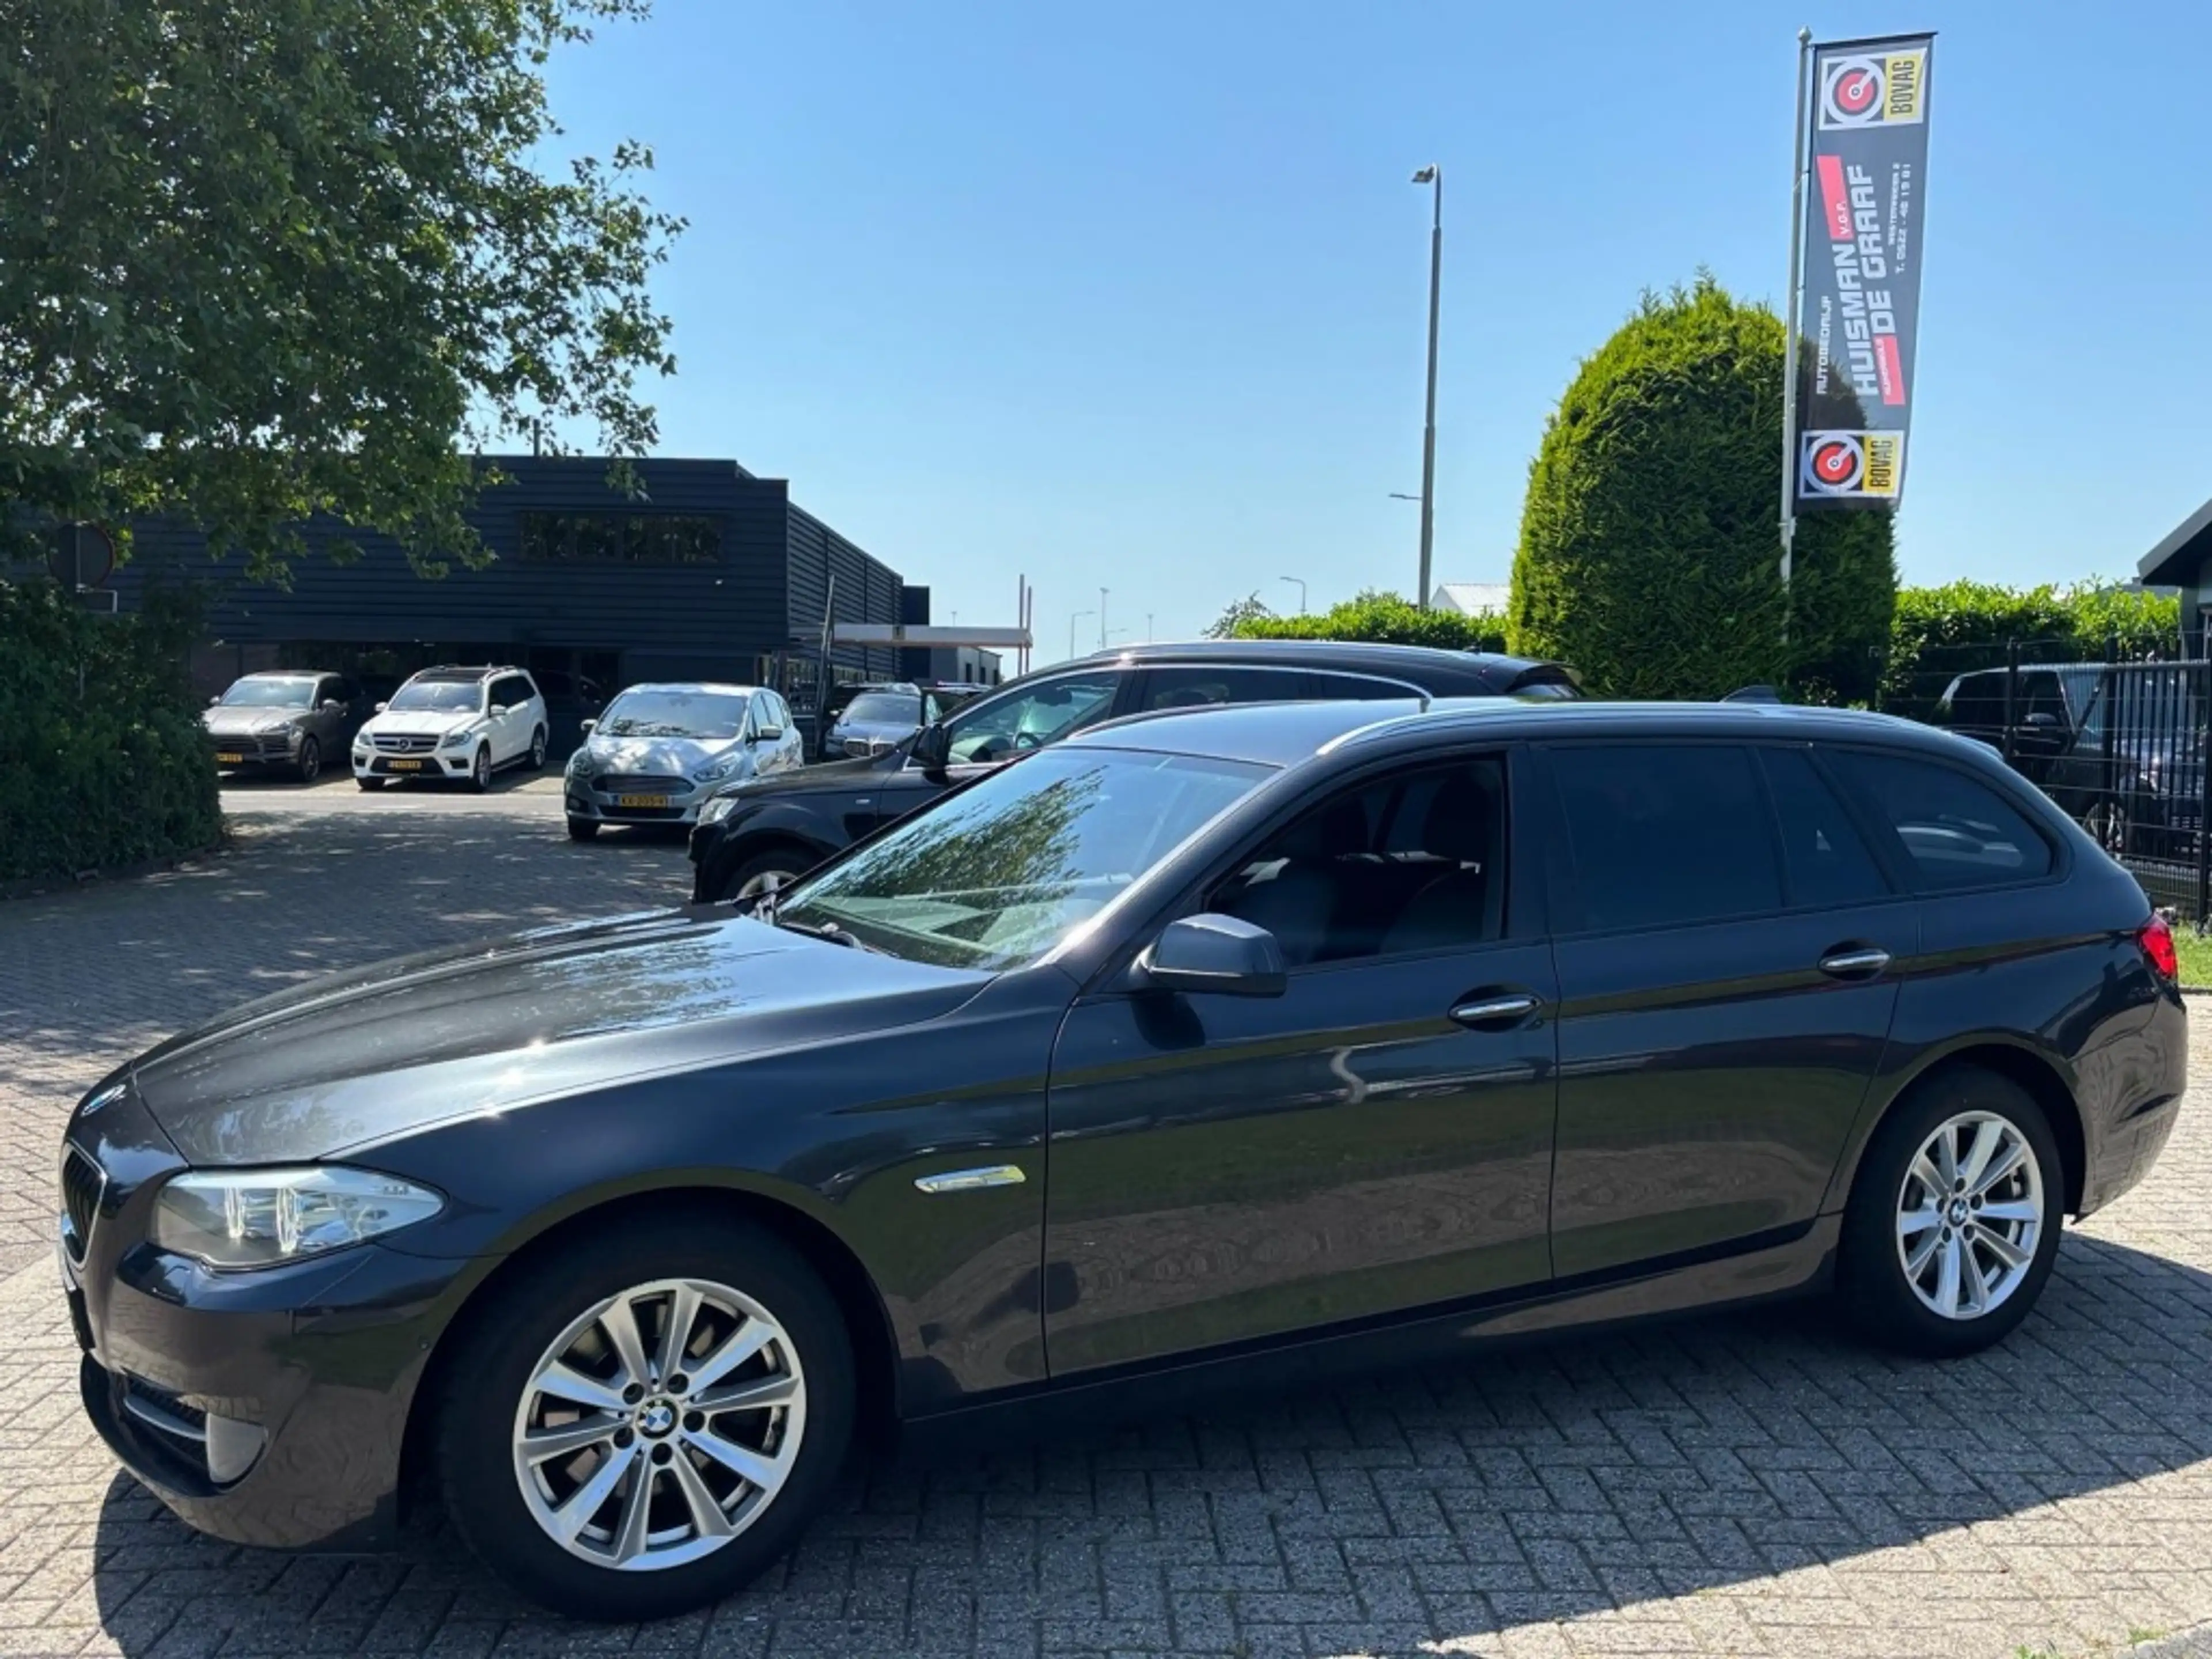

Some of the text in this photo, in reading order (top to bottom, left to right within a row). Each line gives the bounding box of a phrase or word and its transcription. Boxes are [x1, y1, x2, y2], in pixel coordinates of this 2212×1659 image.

[1889, 59, 1915, 115] BOVAG
[1847, 164, 1887, 279] GRAAF
[1816, 295, 1832, 395] AUTOBEDRIJF
[1831, 243, 1879, 396] HUISMAN
[1866, 290, 1896, 334] DE
[1869, 440, 1893, 487] BOVAG
